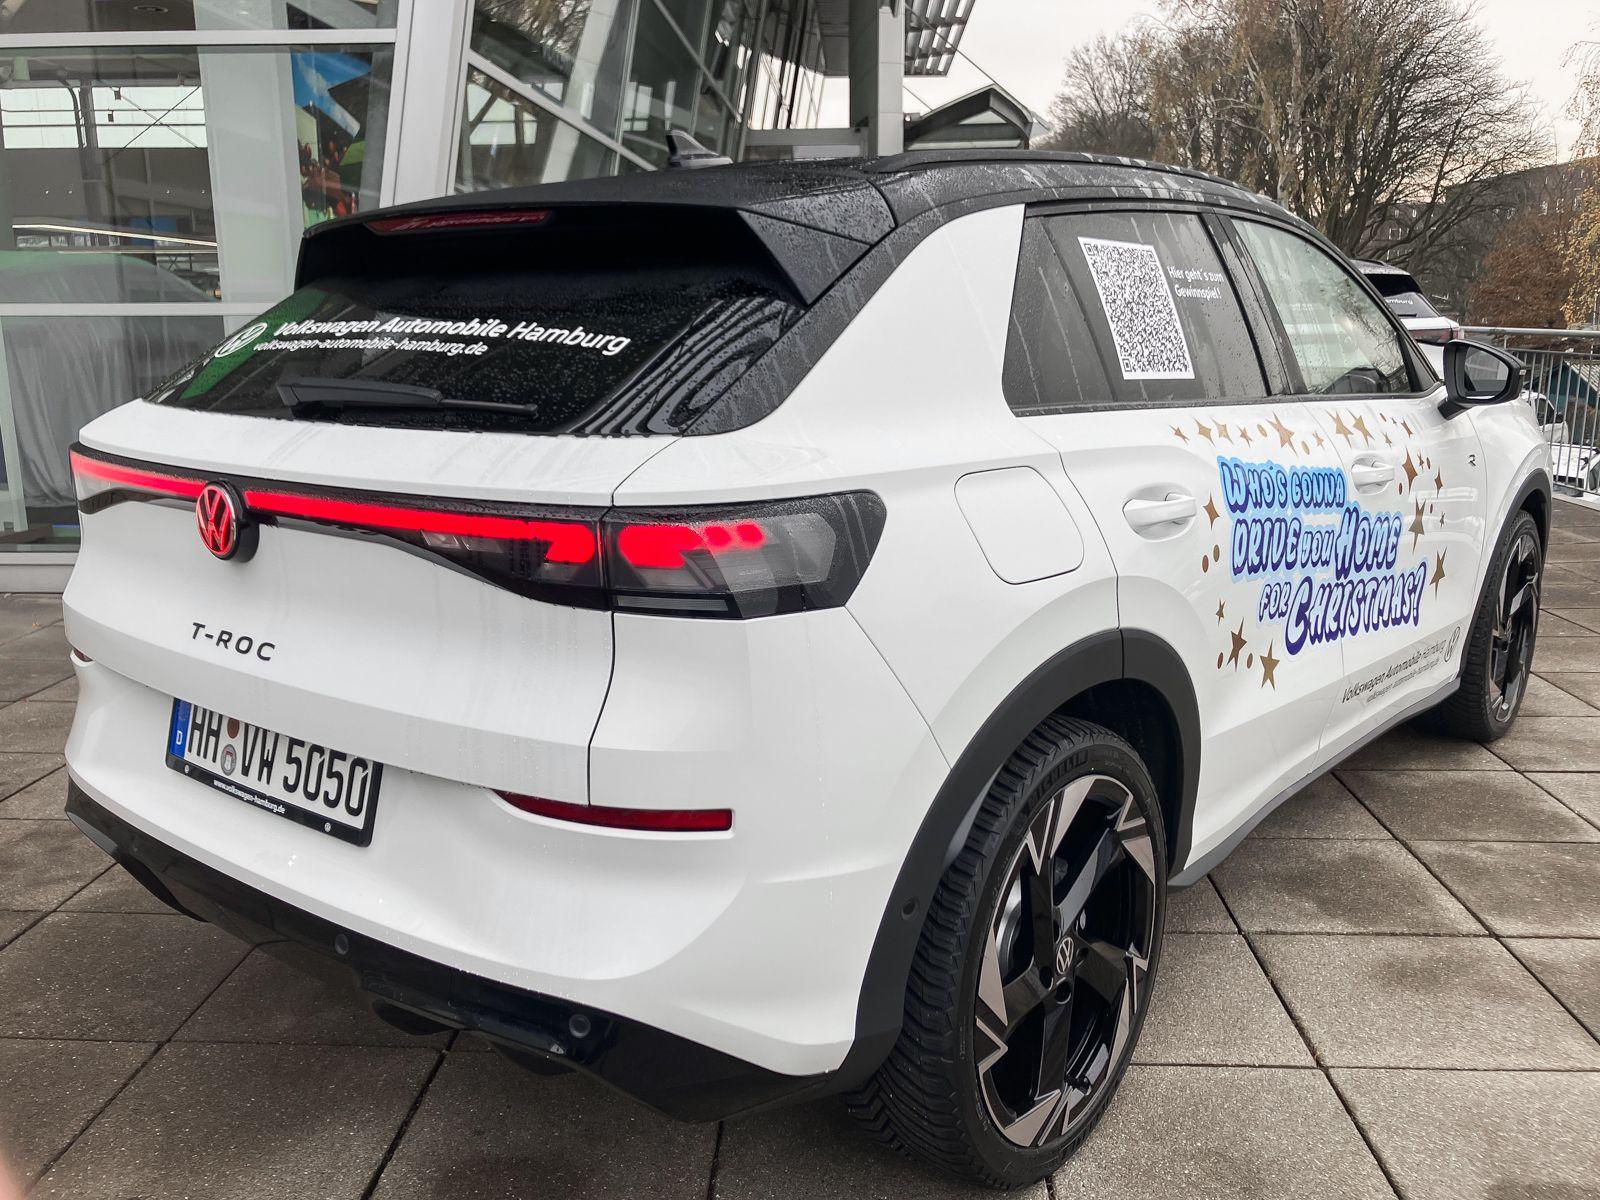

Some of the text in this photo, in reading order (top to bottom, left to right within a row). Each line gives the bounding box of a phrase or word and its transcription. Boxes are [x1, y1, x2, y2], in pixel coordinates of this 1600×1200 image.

[1166, 265, 1185, 280] Hier
[1208, 272, 1225, 282] zum
[1174, 284, 1222, 301] Gewinnspiel!
[253, 337, 489, 357] volkswagen-automobile-hamburg.de
[274, 318, 381, 337] Volkswagen
[376, 316, 509, 338] Automobile
[506, 321, 632, 356] Hamburg
[1232, 517, 1301, 576] DRIVE
[1334, 506, 1401, 581] HOME
[1259, 561, 1427, 656] FOR CHRISTMAS?
[192, 621, 276, 662] T-ROC
[176, 730, 183, 745] D
[188, 704, 369, 817] HH VW 5050
